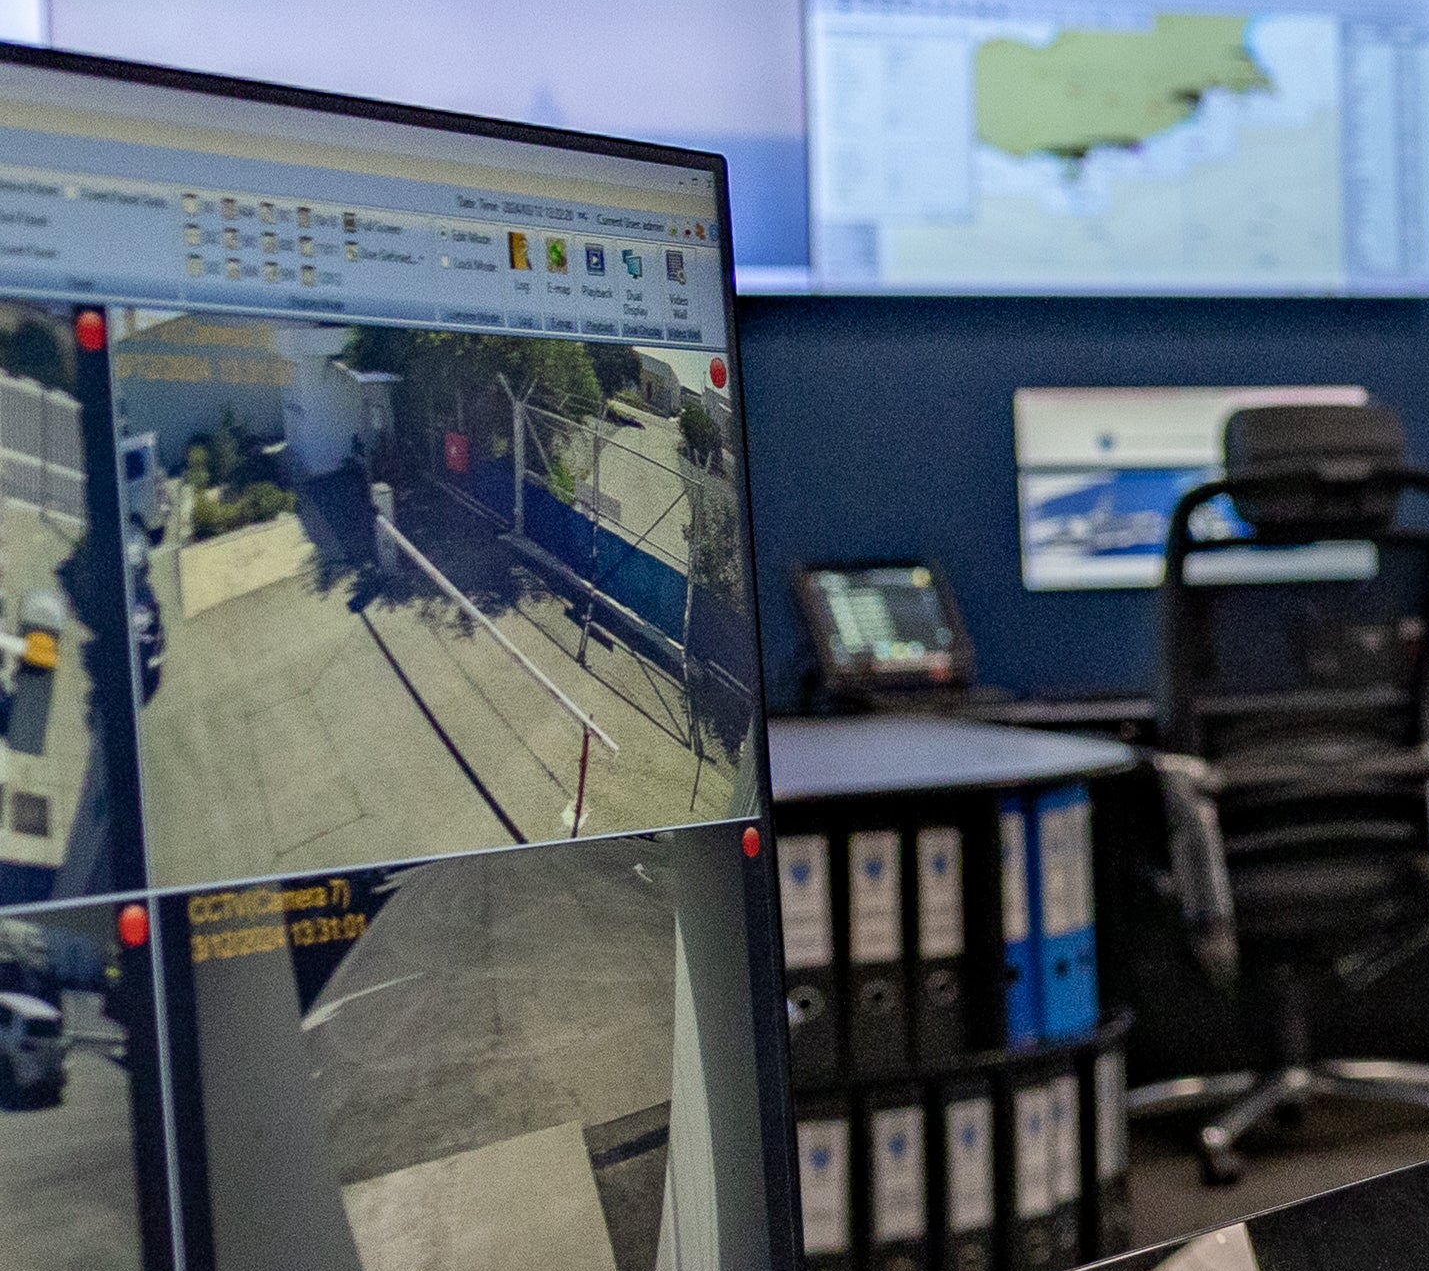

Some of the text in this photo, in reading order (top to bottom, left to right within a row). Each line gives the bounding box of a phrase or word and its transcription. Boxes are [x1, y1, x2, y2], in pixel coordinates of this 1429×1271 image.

[582, 285, 613, 300] Playback
[627, 290, 642, 302] Dual
[669, 294, 688, 307] Video
[623, 304, 648, 319] Display
[673, 309, 688, 321] Wall
